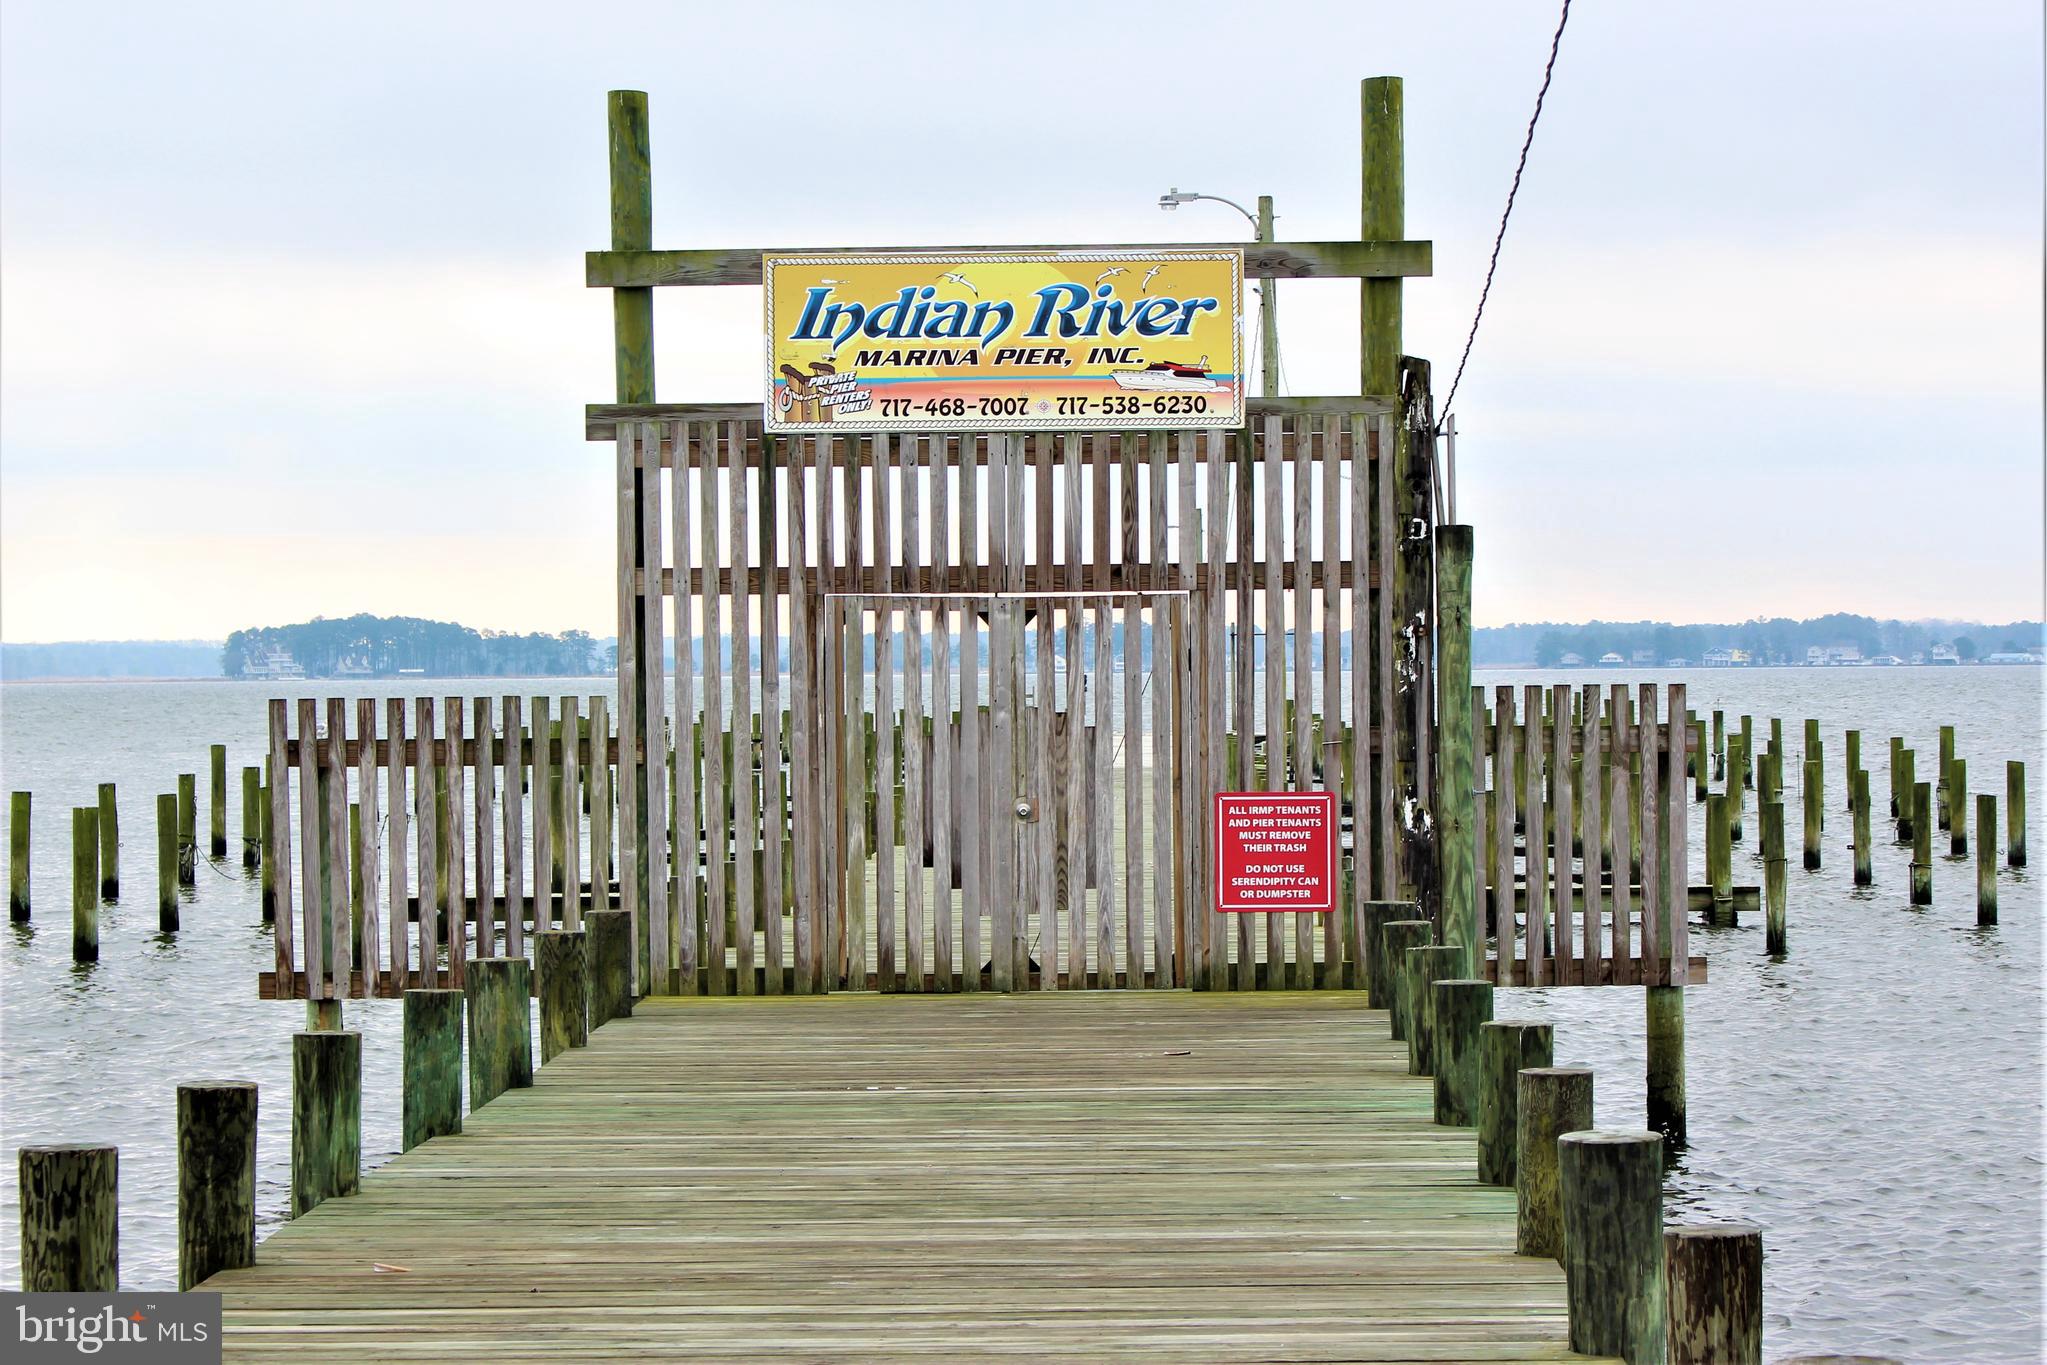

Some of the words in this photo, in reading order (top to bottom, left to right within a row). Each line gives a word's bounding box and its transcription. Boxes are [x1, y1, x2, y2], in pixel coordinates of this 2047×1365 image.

[789, 285, 1015, 353] Indian
[1023, 282, 1218, 340] River
[853, 348, 978, 367] MARINA
[993, 348, 1072, 368] PIER,
[1087, 347, 1144, 364] INC.
[808, 371, 857, 388] PRIVATE
[830, 381, 857, 394] PIER
[821, 390, 872, 406] RENTERS
[838, 400, 873, 414] ONLY!
[880, 397, 1028, 417] 717-468-7007
[1056, 396, 1207, 415] 717-538-6230
[1229, 806, 1247, 814] ALL
[1249, 806, 1274, 814] IRMP
[1276, 806, 1321, 814] TENANTS
[1229, 819, 1250, 827] AND
[1253, 819, 1274, 827] PIER
[1276, 819, 1321, 827] TENANTS
[1270, 831, 1311, 839] REMOVE
[1243, 844, 1272, 852] THEIR
[1274, 844, 1306, 852] TRASH
[1246, 865, 1261, 873] DO
[1263, 865, 1284, 873] NOT
[1286, 865, 1304, 873] USE
[1298, 877, 1318, 885] CAN
[1240, 890, 1254, 898] OR
[1256, 890, 1310, 898] DUMPSTER
